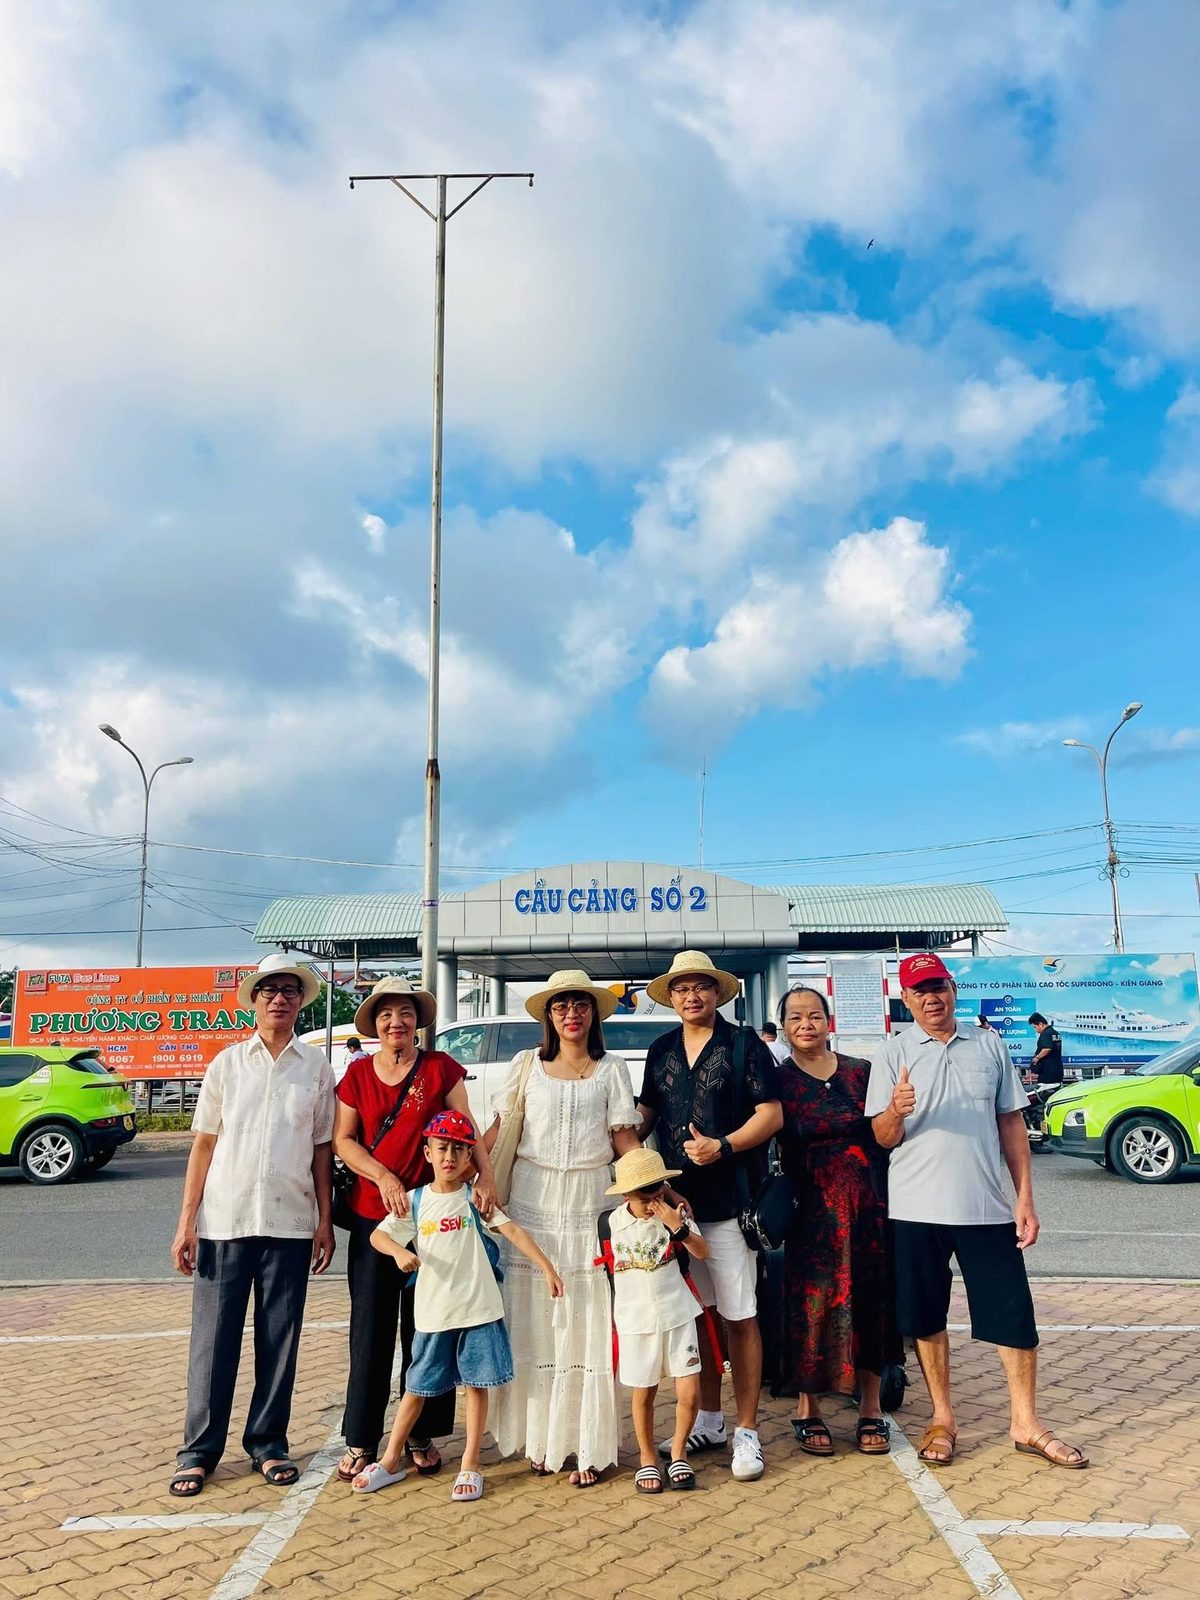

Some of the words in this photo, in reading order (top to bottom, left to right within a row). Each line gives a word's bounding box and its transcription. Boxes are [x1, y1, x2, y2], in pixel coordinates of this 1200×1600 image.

[514, 878, 562, 913] CẦU
[568, 878, 637, 913] CẢNG
[650, 874, 684, 912] SỐ
[689, 886, 708, 911] 2
[48, 973, 72, 984] FUTA
[1071, 980, 1114, 988] SUPERDONG
[1139, 979, 1164, 987] GIANG
[115, 995, 128, 1005] TY
[174, 993, 188, 1003] XE
[29, 1008, 160, 1034] PHƯƠNG
[168, 1009, 256, 1031] TRAN
[109, 1055, 135, 1063] 6067
[152, 1054, 176, 1063] 1900
[179, 1054, 204, 1062] 6919
